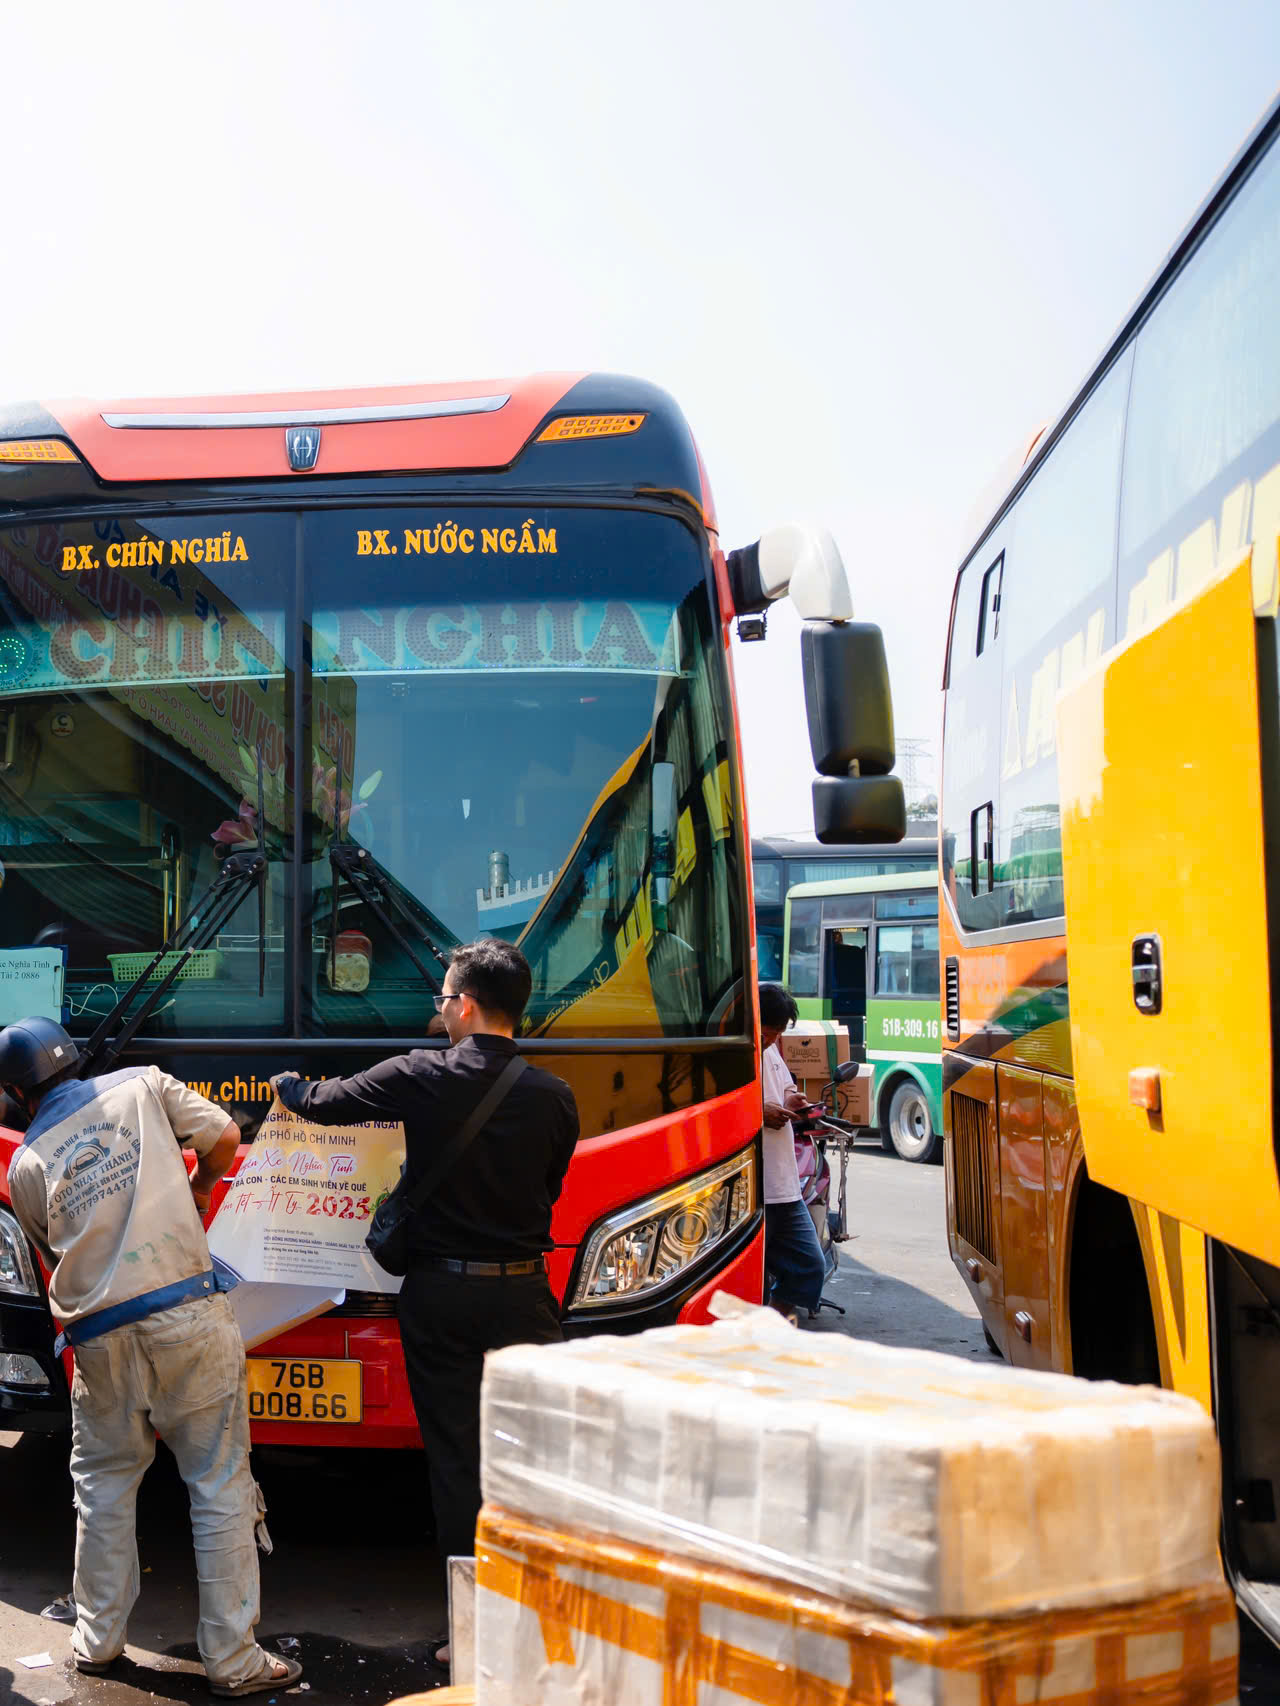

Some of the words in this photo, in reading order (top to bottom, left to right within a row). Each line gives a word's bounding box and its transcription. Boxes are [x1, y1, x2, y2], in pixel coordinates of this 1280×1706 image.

[357, 530, 397, 557] BX.
[405, 524, 476, 556] NƯỚC
[482, 517, 558, 554] NGẦM
[62, 545, 99, 571] BX.
[106, 536, 163, 568] CHÍN
[170, 531, 248, 565] NGHĨA
[882, 1018, 938, 1039] 51B-309.16
[270, 1127, 291, 1141] PHỐ
[293, 1129, 307, 1142] HỒ
[309, 1130, 326, 1145] CHÍ
[328, 1134, 356, 1146] MINH
[246, 1176, 263, 1185] CON
[270, 1174, 287, 1184] CÁC
[288, 1176, 300, 1185] EM
[301, 1178, 319, 1188] SINH
[319, 1178, 337, 1190] VIÊN
[351, 1182, 367, 1192] QUÊ
[306, 1191, 371, 1221] 2025
[271, 1362, 324, 1389] 76B
[249, 1392, 347, 1419] 008.66
